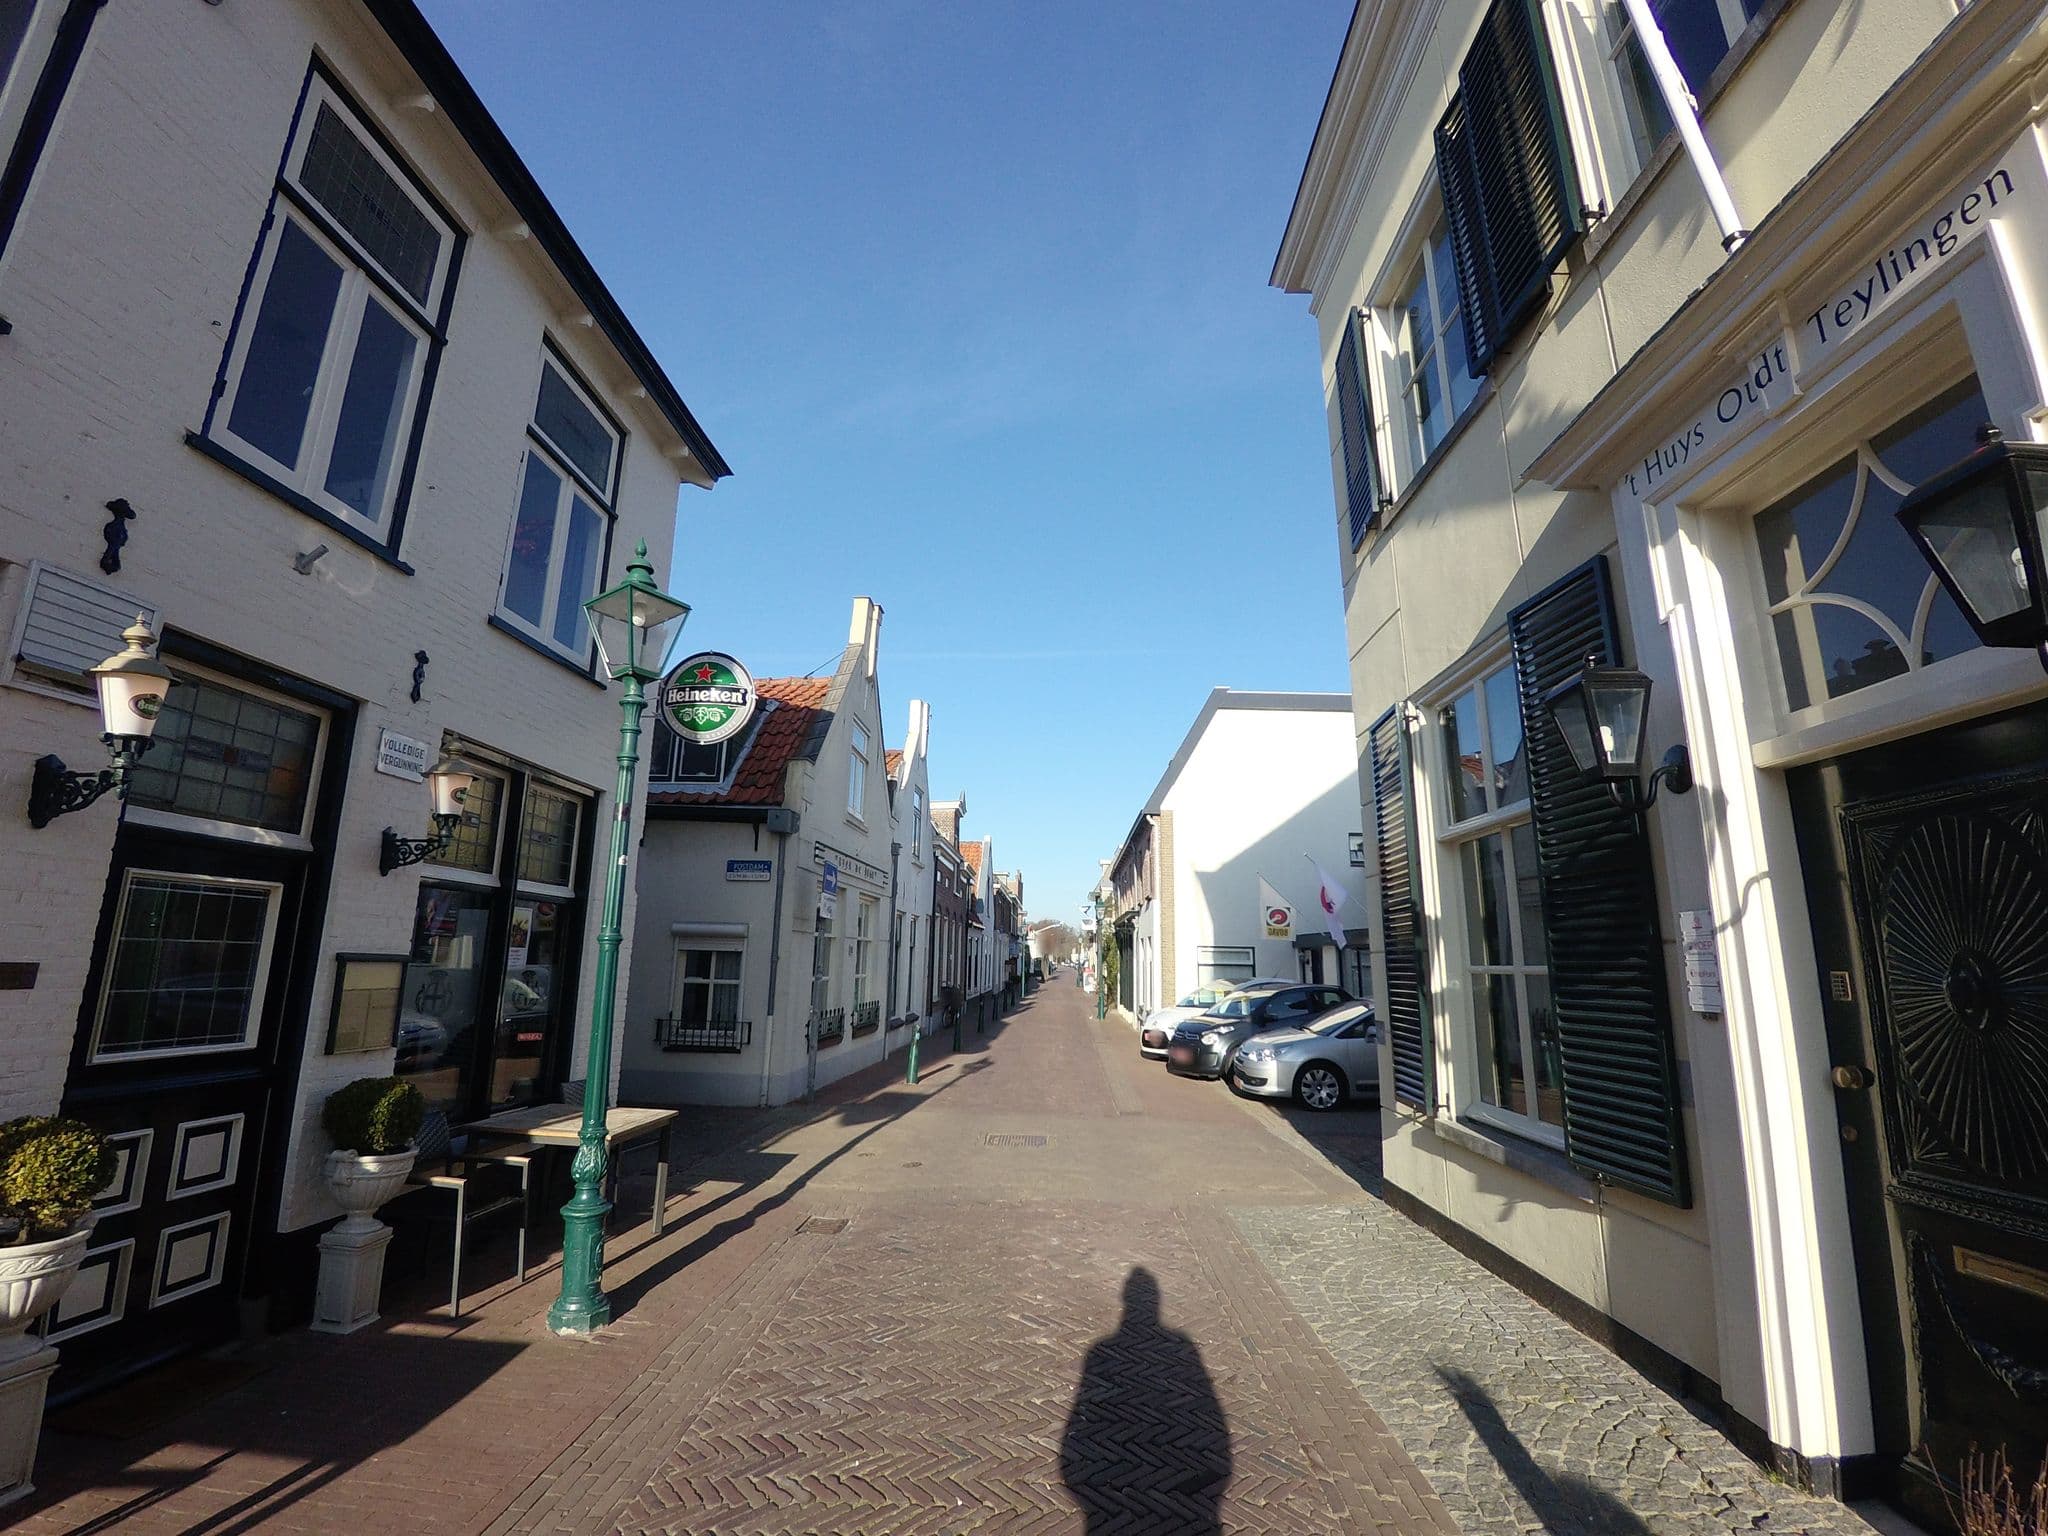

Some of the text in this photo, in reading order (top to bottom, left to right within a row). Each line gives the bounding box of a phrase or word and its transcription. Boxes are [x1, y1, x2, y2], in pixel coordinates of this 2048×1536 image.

[1625, 474, 1639, 496] 't
[1643, 421, 1704, 485] Huys
[1806, 167, 2015, 344] Teylingen
[667, 687, 744, 704] Heineken
[383, 737, 425, 760] VOLLEDIGE
[380, 751, 425, 773] VERGUNNING
